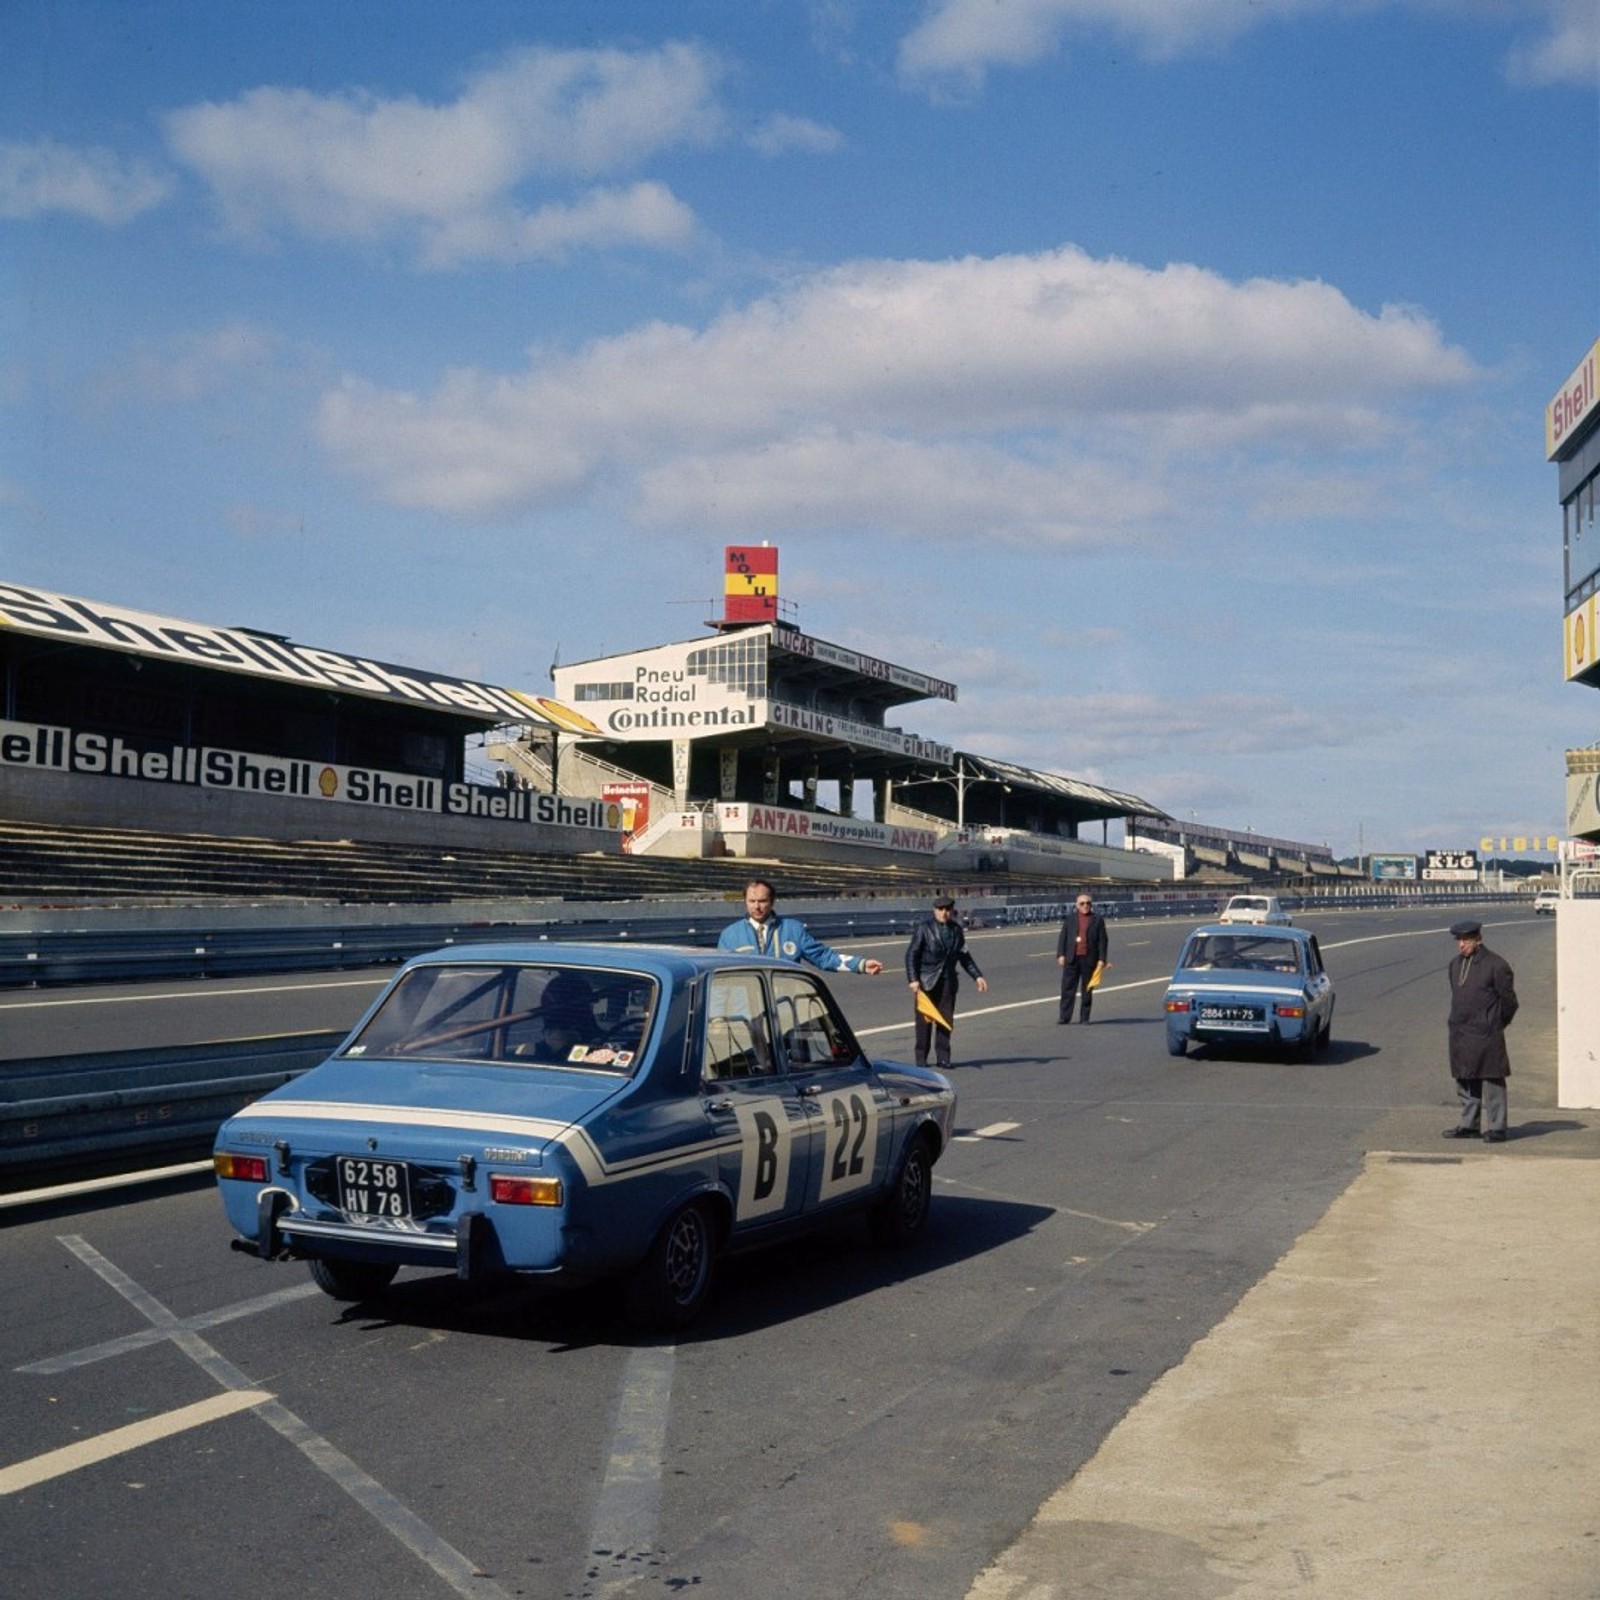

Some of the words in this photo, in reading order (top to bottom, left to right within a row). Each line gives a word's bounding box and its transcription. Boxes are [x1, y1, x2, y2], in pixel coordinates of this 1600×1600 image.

[1554, 358, 1594, 441] Shell
[730, 552, 774, 608] MOTUL
[0, 585, 317, 677] Shell
[293, 648, 550, 723] Shell
[636, 667, 684, 682] Pneu
[777, 628, 815, 657] LUCAS
[859, 656, 892, 681] LUCAS
[928, 678, 956, 701] LUCAS
[608, 706, 756, 732] Continental
[636, 684, 696, 702] Radial
[773, 705, 833, 735] GIRLING
[903, 738, 949, 763] GIRLING
[74, 732, 197, 783] Shell
[205, 750, 311, 795] Shell
[347, 770, 434, 809] Shell
[449, 783, 524, 819] Shell
[537, 795, 603, 828] Shell
[603, 785, 648, 795] Heineken
[750, 807, 810, 835] ANTAR
[890, 827, 937, 851] ANTAR
[753, 1111, 779, 1200] B
[831, 1093, 868, 1182] 22
[346, 1188, 368, 1213] HV
[376, 1192, 402, 1216] 78
